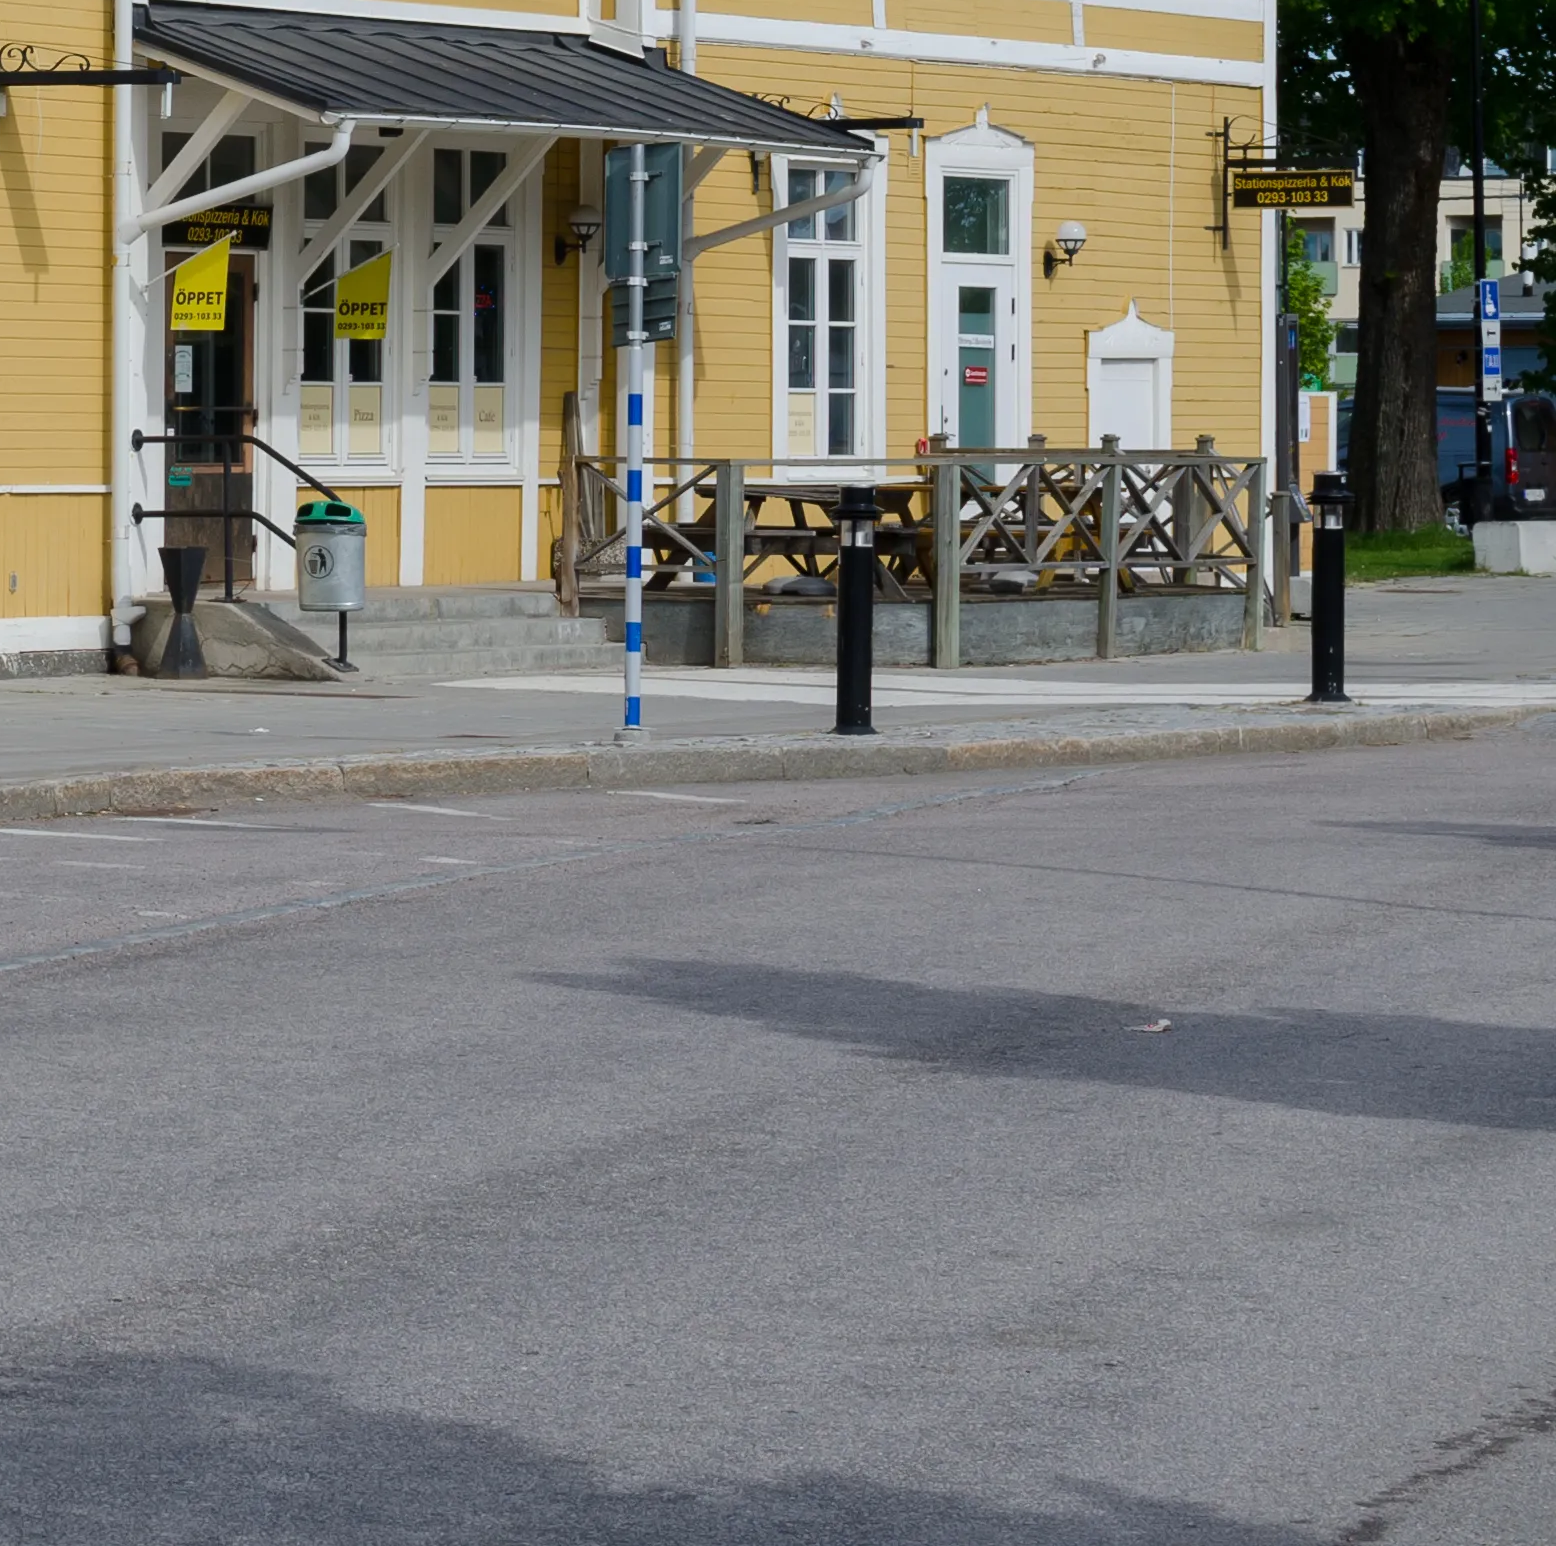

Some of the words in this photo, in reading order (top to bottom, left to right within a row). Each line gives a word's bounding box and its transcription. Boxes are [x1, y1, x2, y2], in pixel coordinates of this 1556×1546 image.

[1235, 177, 1317, 190] Stationspizzeria
[1320, 176, 1328, 187] &
[1331, 175, 1352, 187] Kök
[1257, 191, 1311, 203] 0293-103
[1314, 191, 1328, 202] 33
[241, 210, 250, 225] &
[176, 288, 224, 305] ÖPPET
[339, 299, 387, 316] ÖPPET
